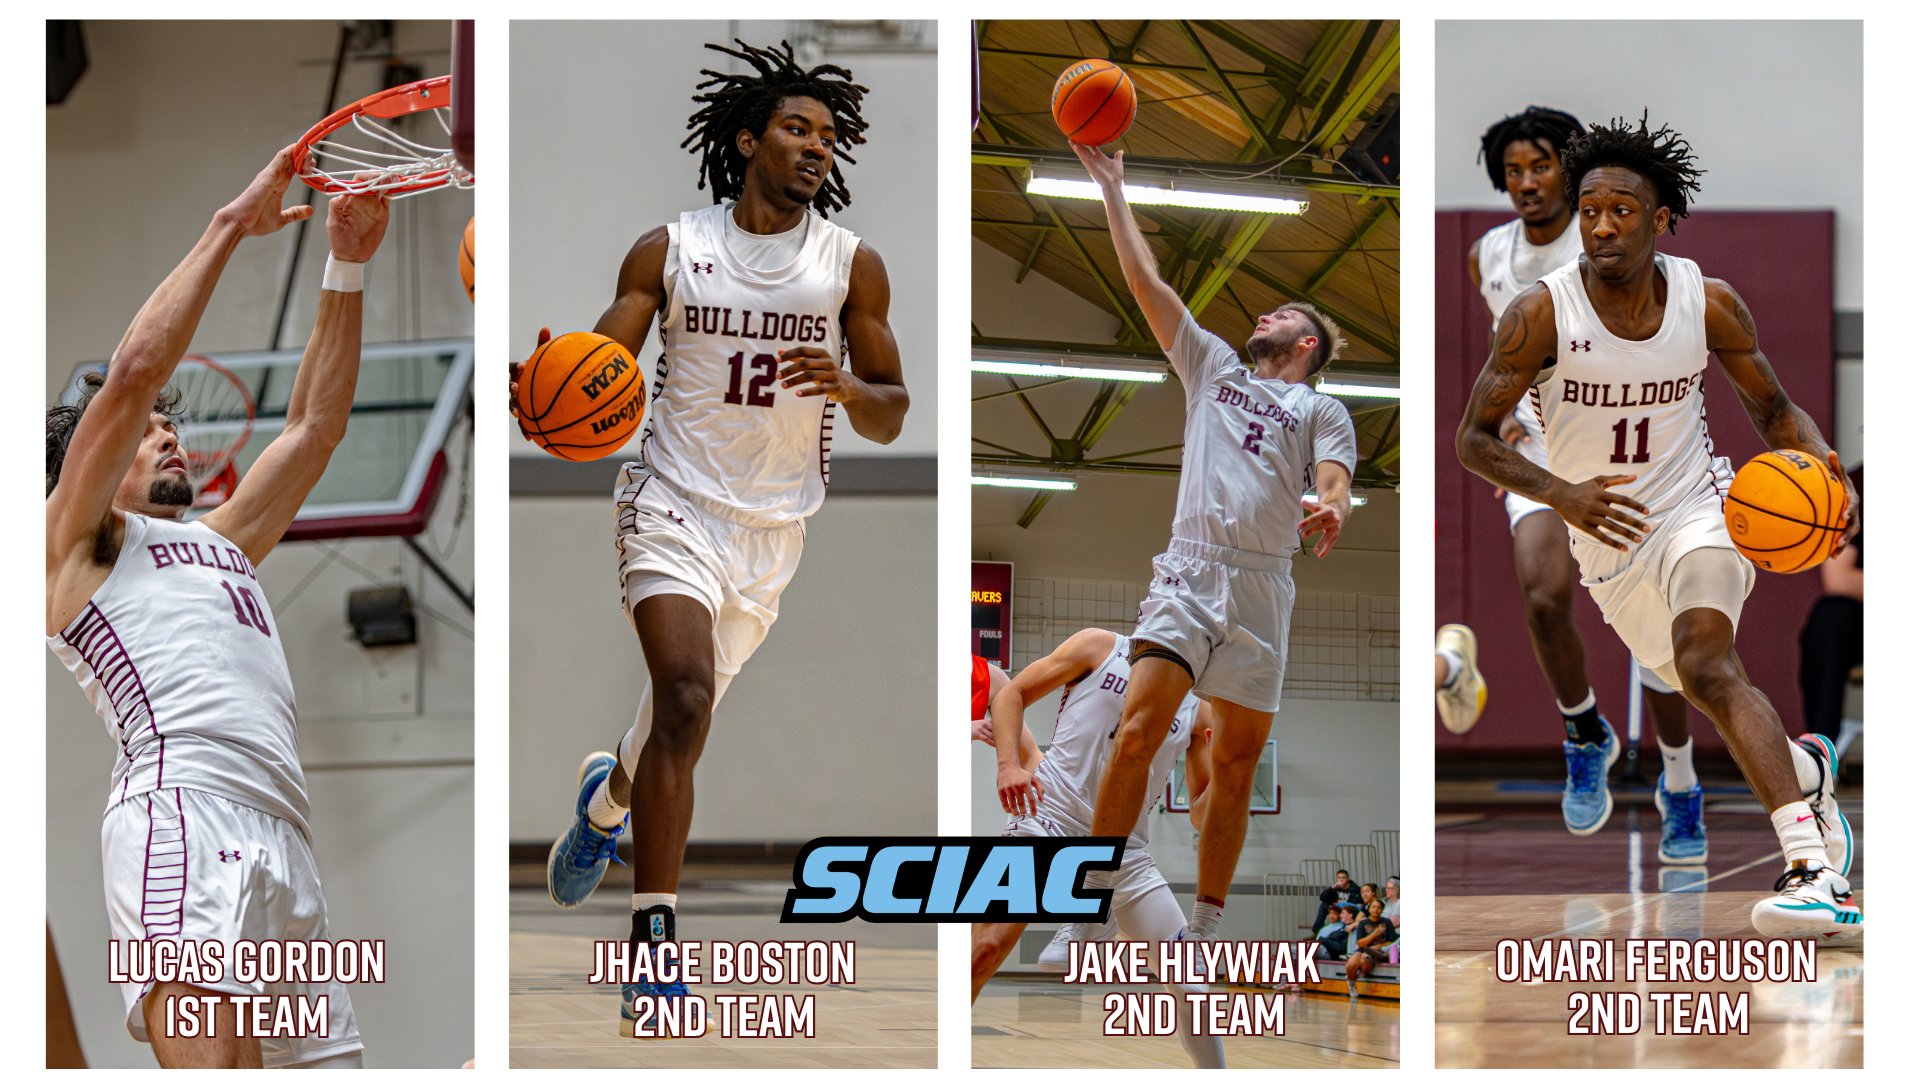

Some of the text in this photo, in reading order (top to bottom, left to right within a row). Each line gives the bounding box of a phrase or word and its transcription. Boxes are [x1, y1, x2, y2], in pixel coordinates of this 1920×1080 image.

[685, 304, 827, 342] BULLDOGS
[581, 352, 630, 401] NCAA
[723, 351, 778, 408] 12
[1242, 421, 1265, 456] 2
[1609, 417, 1651, 464] 11
[220, 579, 271, 638] 10
[971, 591, 1002, 603] AVERS
[980, 629, 1003, 639] FOULS
